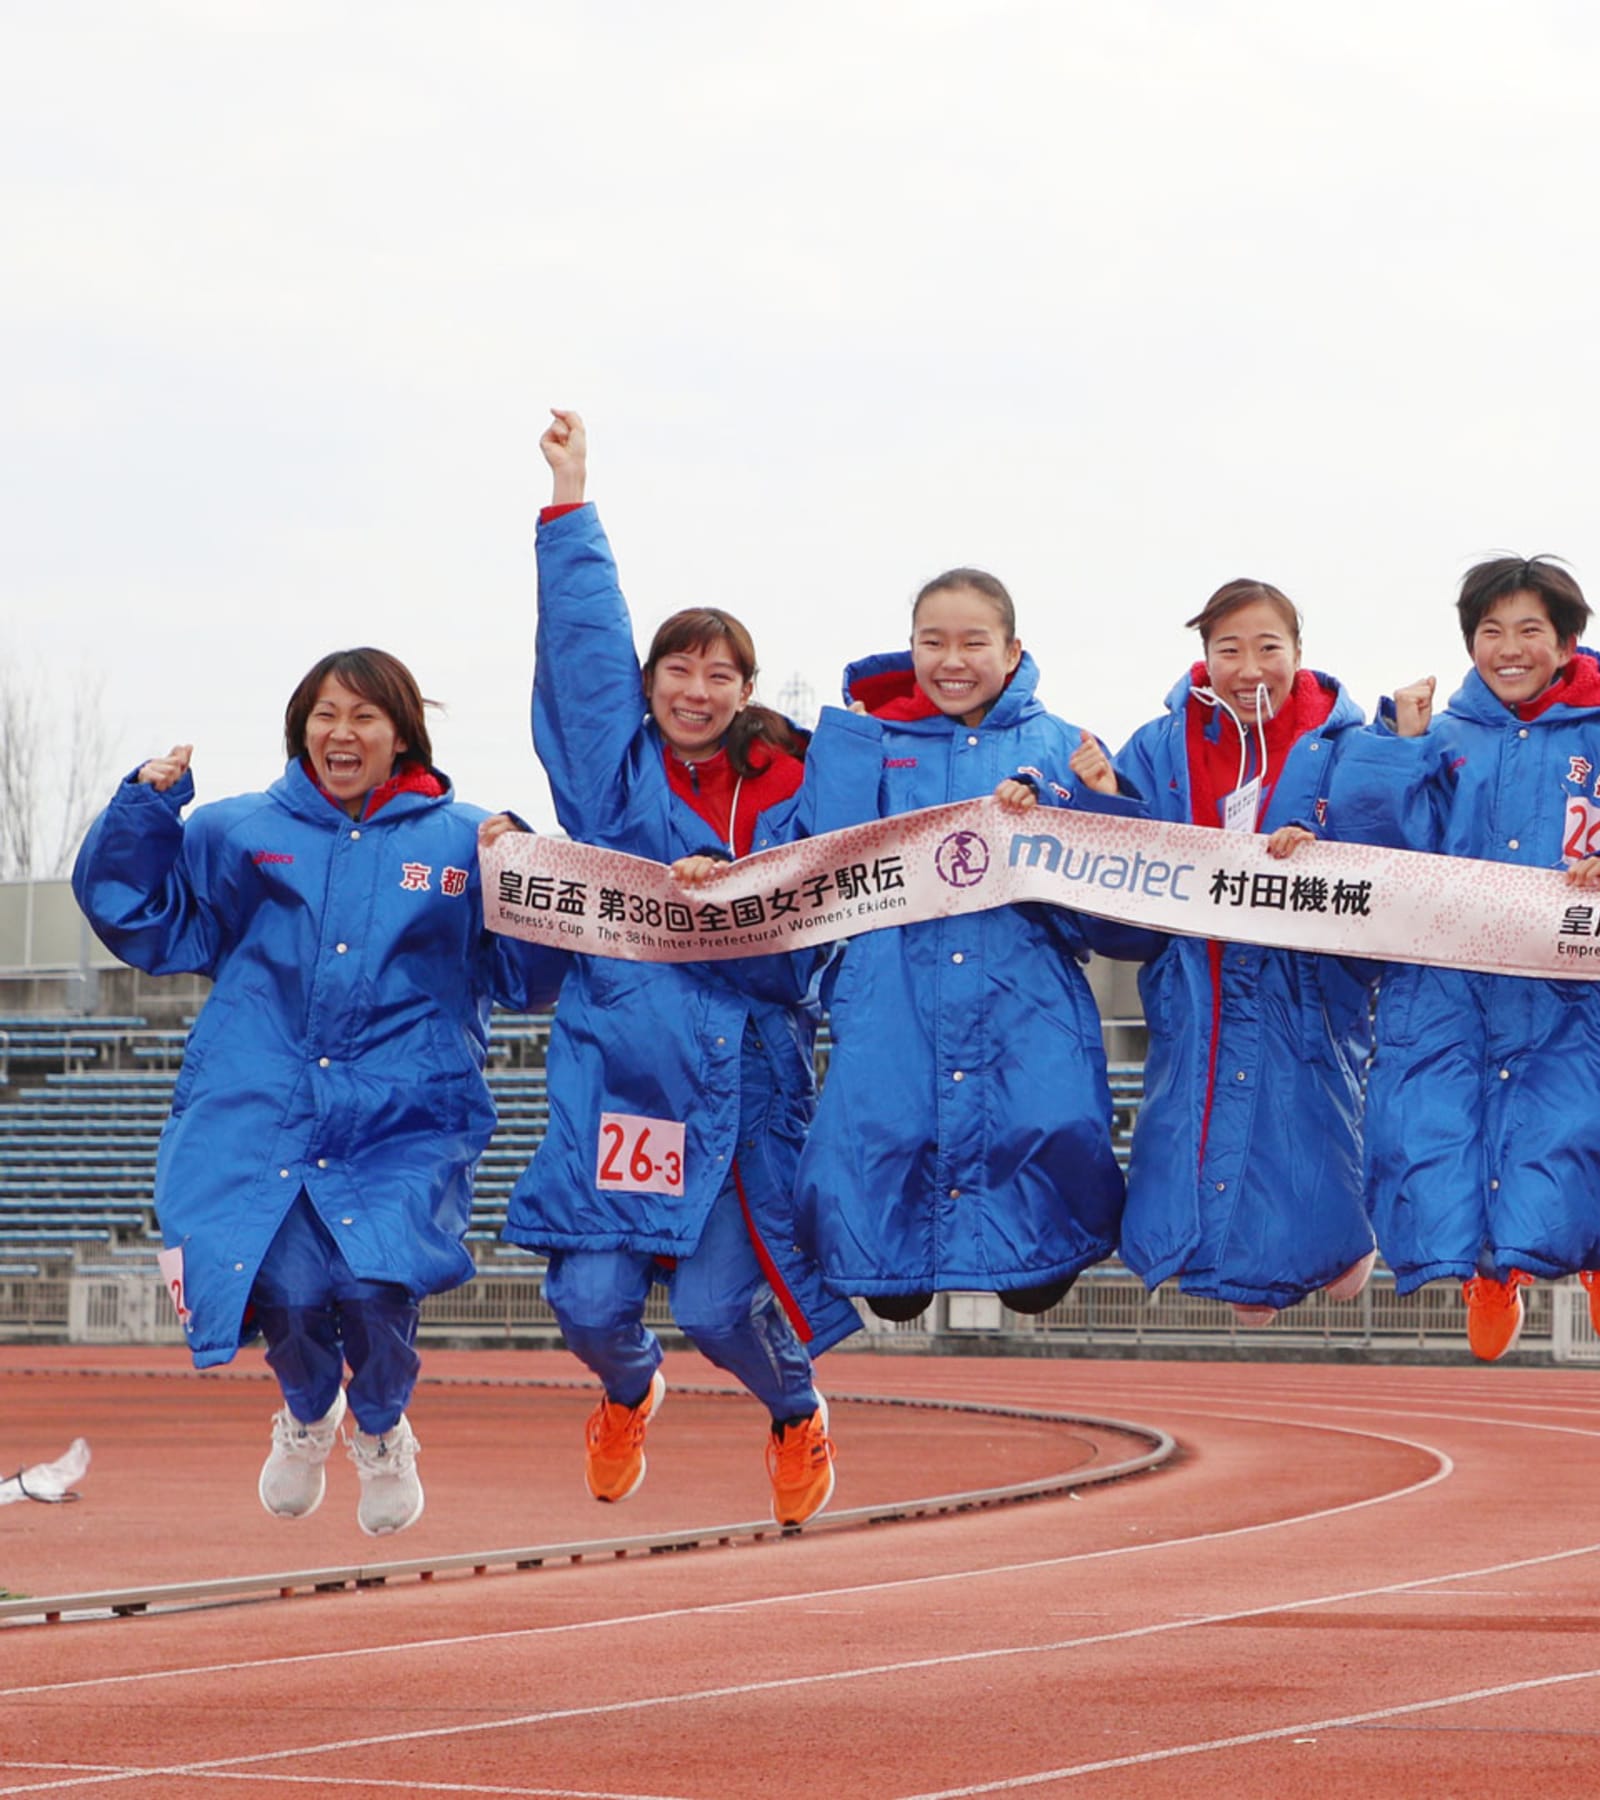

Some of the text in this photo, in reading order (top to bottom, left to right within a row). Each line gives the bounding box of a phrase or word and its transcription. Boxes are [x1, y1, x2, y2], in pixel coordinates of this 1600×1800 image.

[400, 863, 468, 896] 京都
[499, 856, 905, 932] 皇后盃 第38回全国女子駅伝
[1210, 869, 1373, 917] 村田機械
[500, 896, 908, 950] Empress's Cup The 38th Inter-Prefectural Women's Ekiden
[600, 1122, 681, 1185] 26-3
